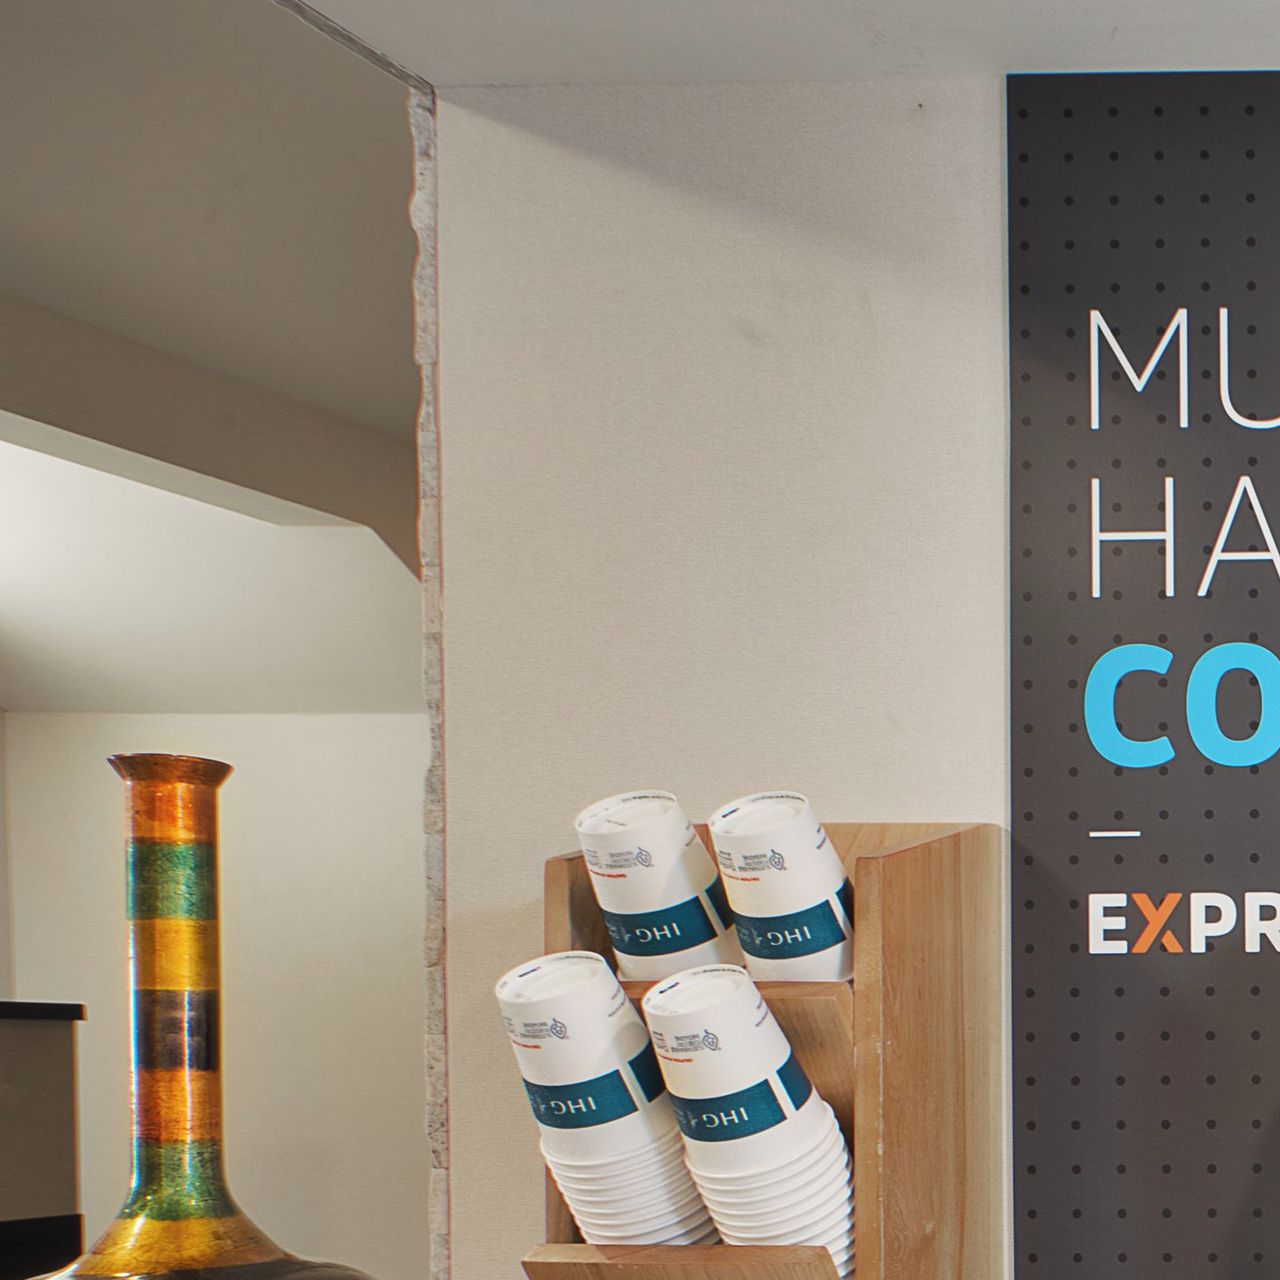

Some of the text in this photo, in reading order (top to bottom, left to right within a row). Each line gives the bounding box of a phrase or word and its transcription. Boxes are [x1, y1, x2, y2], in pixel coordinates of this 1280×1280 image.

[635, 922, 681, 943] IHG
[766, 926, 812, 946] IHG
[551, 1096, 597, 1115] IHG
[702, 1107, 749, 1128] IHG
